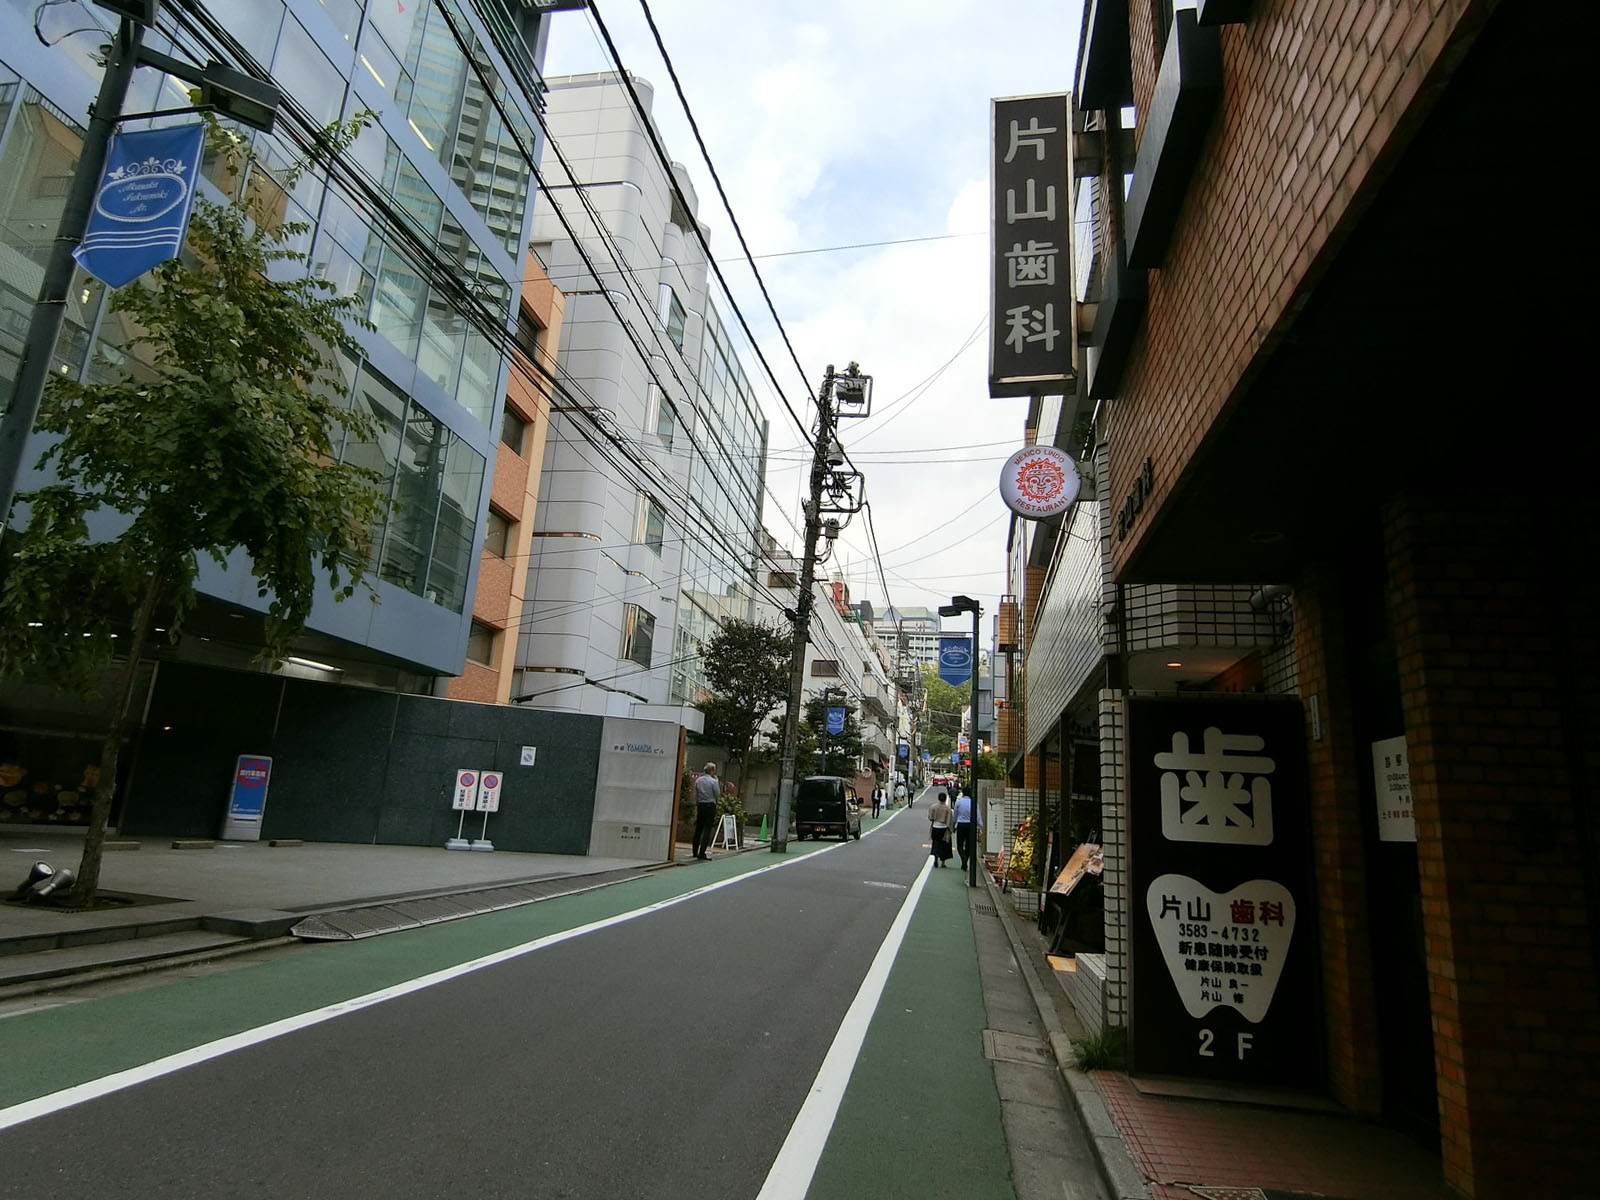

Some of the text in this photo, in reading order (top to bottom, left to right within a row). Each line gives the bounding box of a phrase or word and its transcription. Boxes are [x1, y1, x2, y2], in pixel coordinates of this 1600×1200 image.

[1004, 117, 1060, 354] 片山歯科
[1014, 449, 1065, 465] MEXICO LINDO
[1015, 496, 1068, 513] RESTAURANT
[1154, 726, 1276, 846] 歯
[1160, 894, 1285, 927] 片山 歯科
[1179, 923, 1260, 942] 3583-4732
[1178, 941, 1269, 961] 新患随時受付
[1184, 958, 1263, 976] 健康保険取扱
[1200, 976, 1222, 989] 片山
[1200, 991, 1222, 1003] 片山
[1198, 1028, 1254, 1060] 2 F
